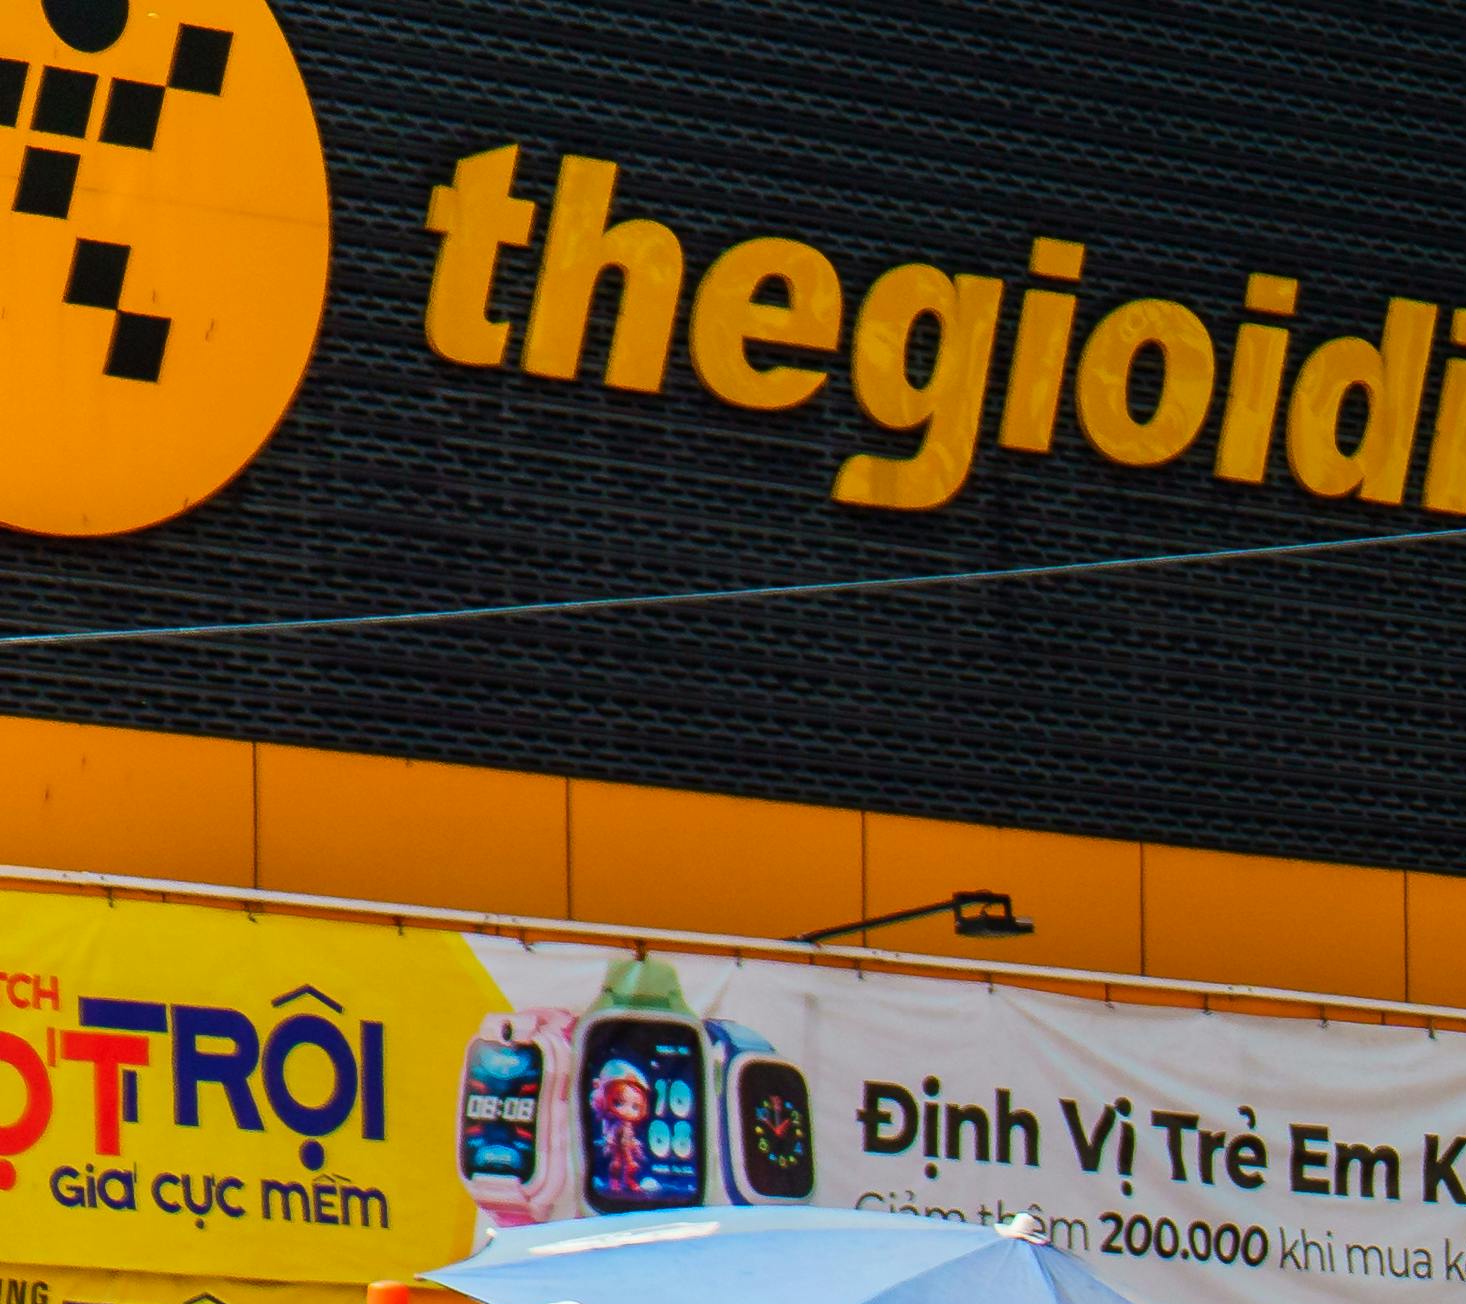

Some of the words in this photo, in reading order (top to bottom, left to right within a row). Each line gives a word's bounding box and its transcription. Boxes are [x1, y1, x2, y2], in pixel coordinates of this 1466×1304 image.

[78, 984, 385, 1171] TRỘI
[856, 1075, 1040, 1180] Định
[1058, 1096, 1136, 1197] Vị
[1151, 1106, 1268, 1190] Trẻ
[1289, 1122, 1401, 1200] Em
[1099, 1210, 1270, 1267] 200.000
[1278, 1226, 1335, 1273] khi
[1346, 1243, 1434, 1280] mua
